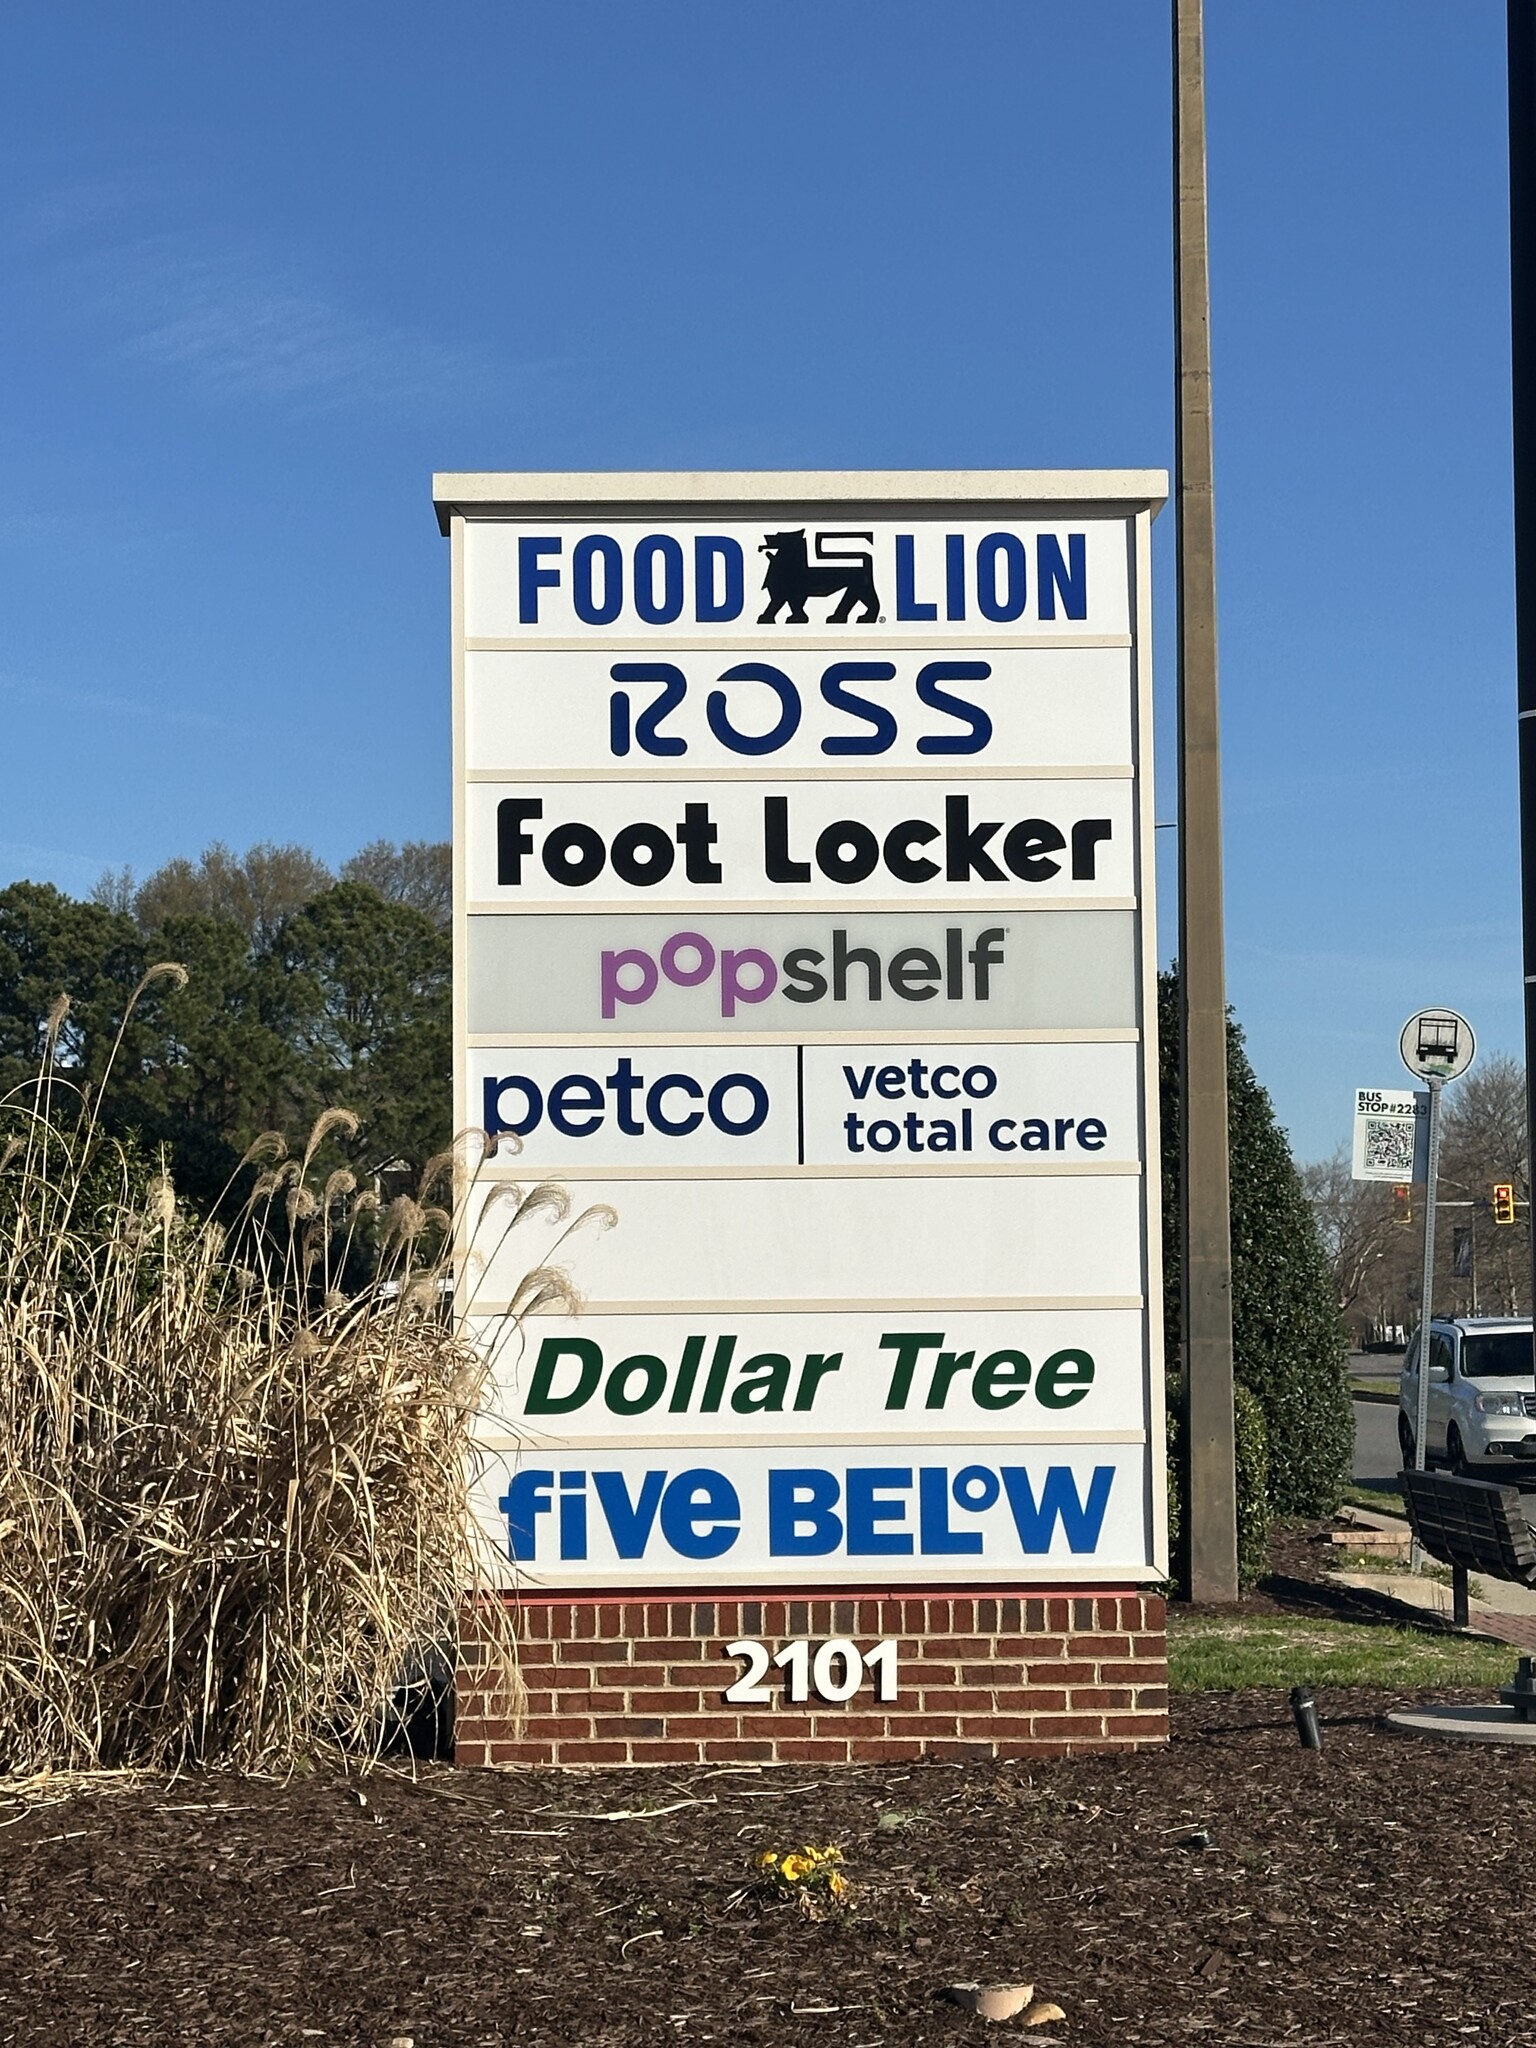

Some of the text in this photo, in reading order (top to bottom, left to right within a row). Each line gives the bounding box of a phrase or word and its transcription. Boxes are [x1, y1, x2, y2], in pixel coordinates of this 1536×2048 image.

[519, 532, 1088, 625] FOOD LION
[610, 661, 993, 757] ROSS
[497, 794, 1113, 887] Foot Locker
[600, 928, 1005, 1020] popshelf
[483, 1057, 770, 1158] petco
[842, 1058, 998, 1100] vetco
[1358, 1091, 1382, 1102] BUS
[843, 1108, 1108, 1153] total care
[523, 1332, 1095, 1416] Dollar Tree
[498, 1464, 1117, 1561] five BELOW
[724, 1638, 899, 1703] 2101
